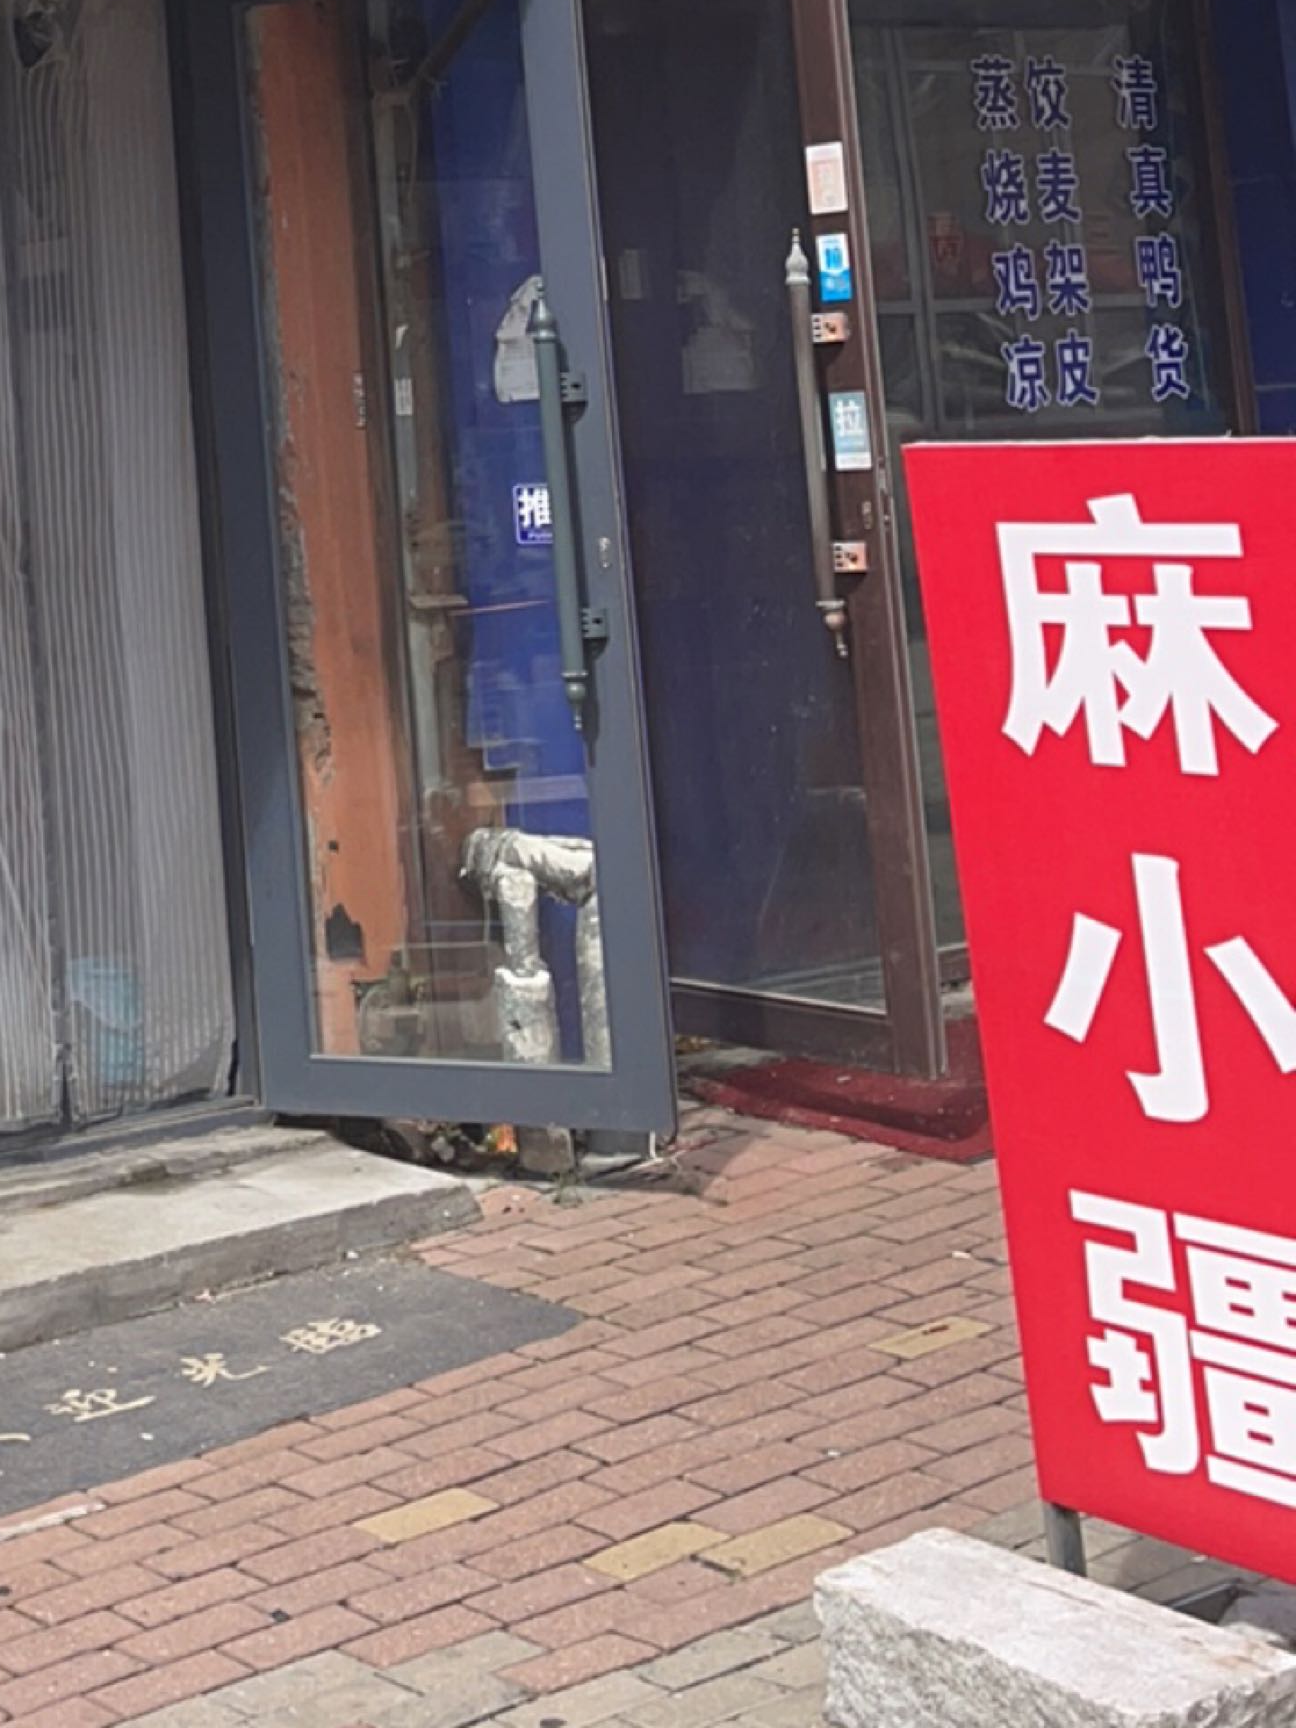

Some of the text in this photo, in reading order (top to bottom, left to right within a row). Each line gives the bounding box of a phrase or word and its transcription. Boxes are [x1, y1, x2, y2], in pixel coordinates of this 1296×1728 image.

[970, 54, 1073, 131] 蒸饺
[981, 147, 1082, 223] 烧麦
[1112, 54, 1189, 403] 清真鸭货
[992, 238, 1091, 320] 鸡架
[1002, 330, 1099, 412] 凉皮
[998, 491, 1296, 1507] 麻小疆
